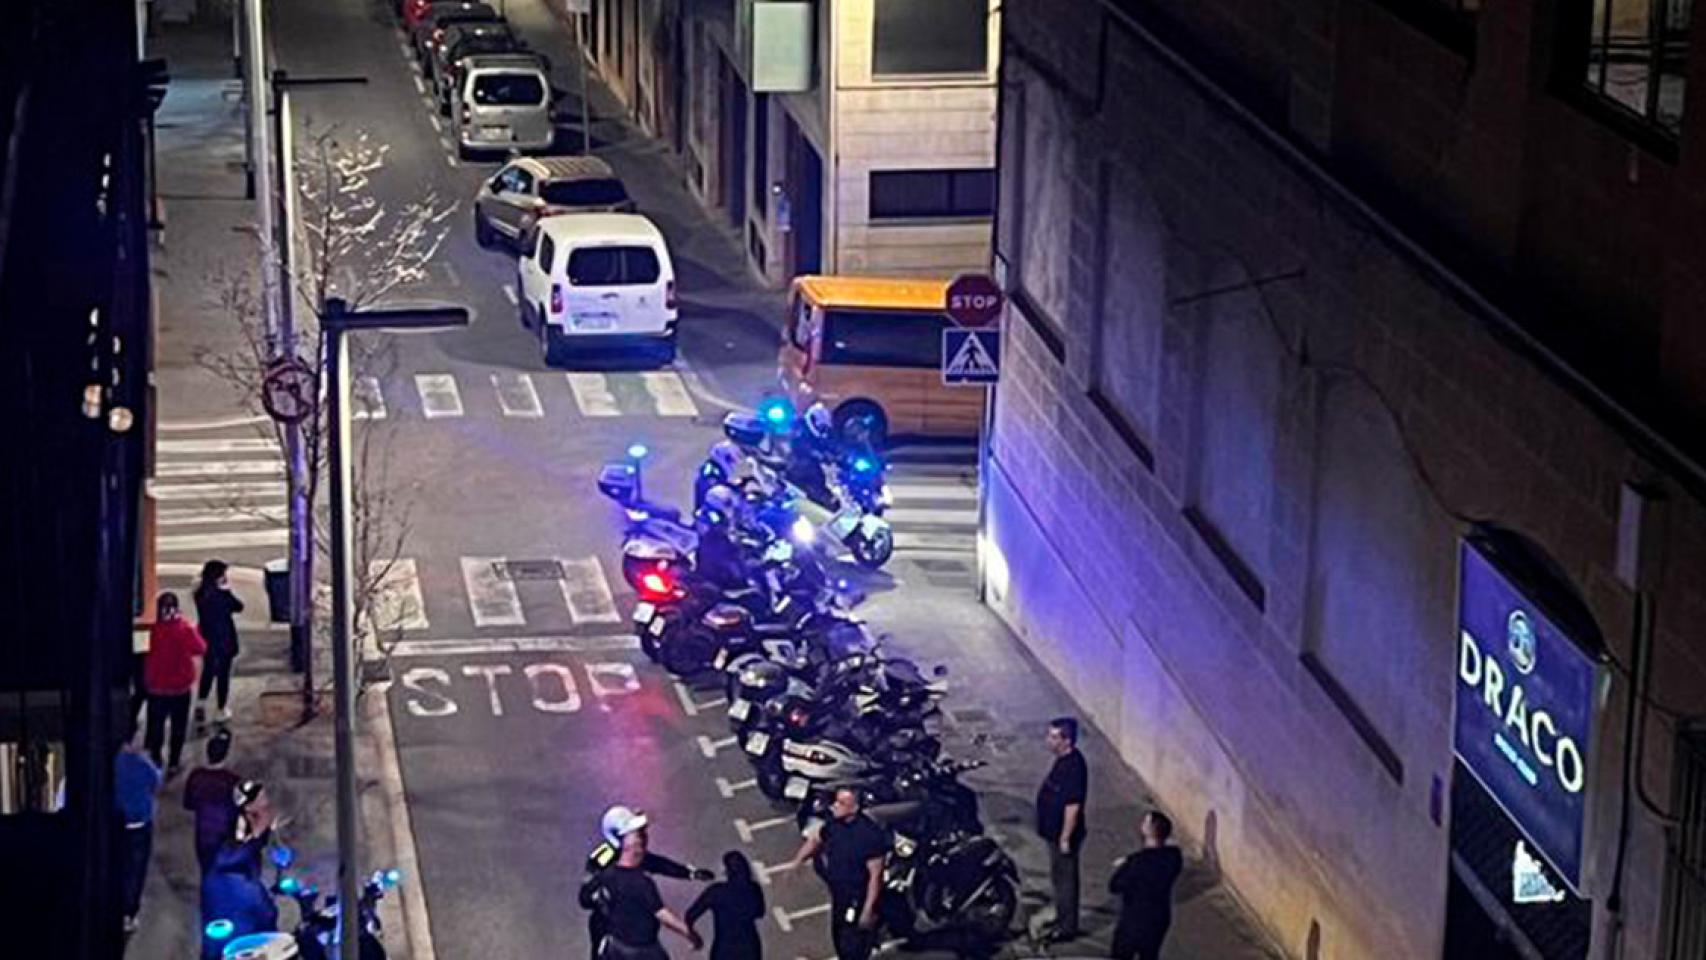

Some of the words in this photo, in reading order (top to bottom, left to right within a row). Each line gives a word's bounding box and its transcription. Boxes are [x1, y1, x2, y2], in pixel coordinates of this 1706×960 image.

[951, 295, 998, 309] STOP
[401, 663, 641, 716] STOP
[1460, 630, 1583, 792] DRACO
